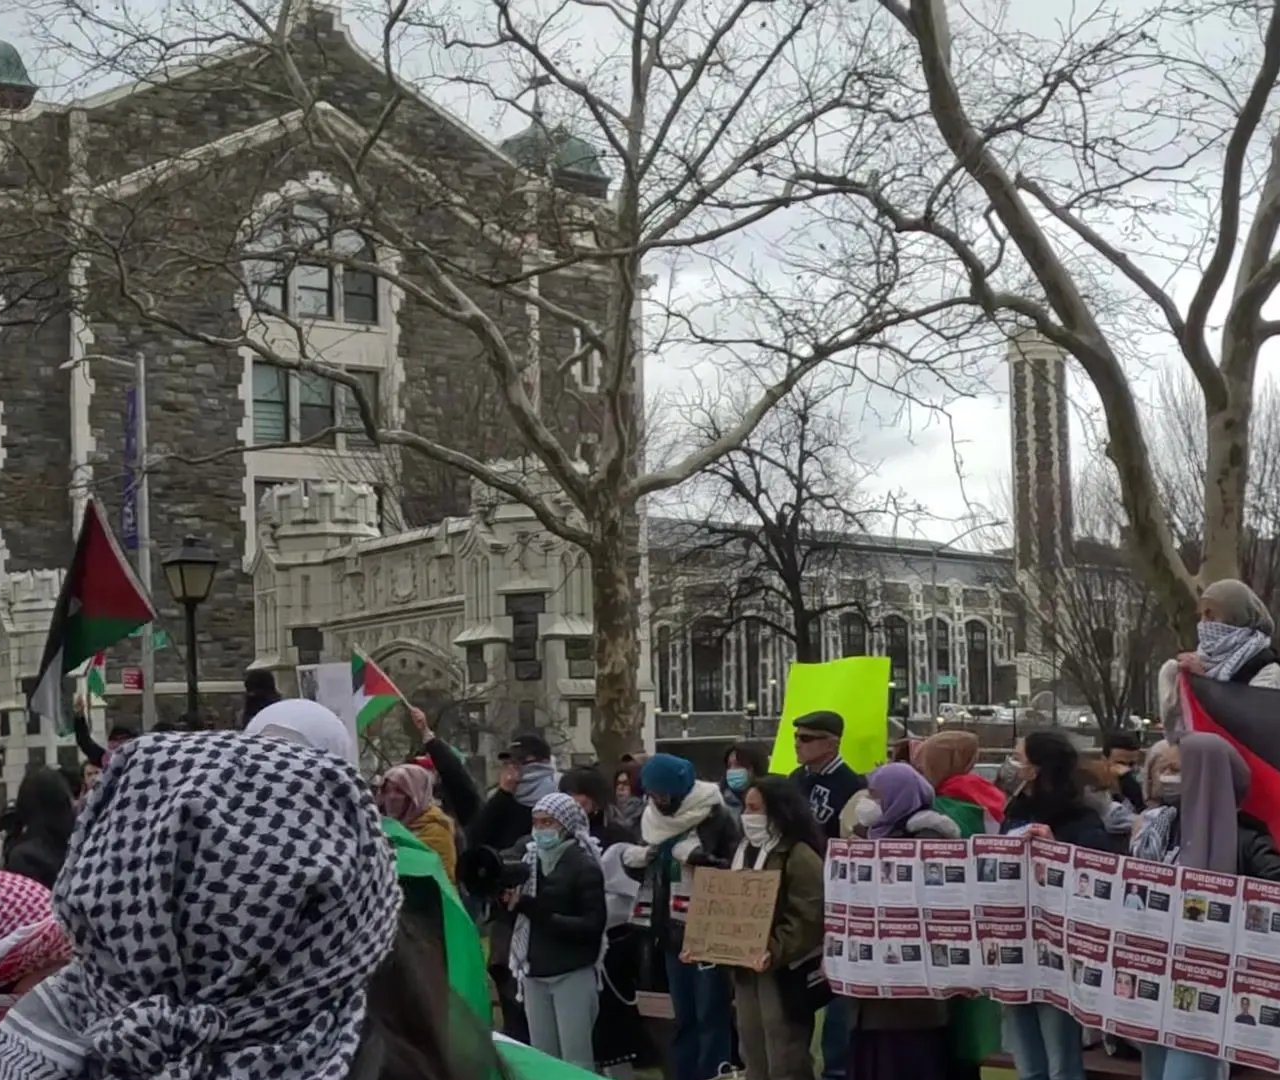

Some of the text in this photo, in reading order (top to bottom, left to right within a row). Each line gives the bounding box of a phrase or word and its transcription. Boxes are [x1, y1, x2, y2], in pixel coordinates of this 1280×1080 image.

[974, 837, 1023, 848] MURDERED
[1076, 849, 1116, 866] MURDERED
[1126, 860, 1174, 876] MURDERED
[1185, 870, 1235, 888] MURDERED
[1115, 948, 1164, 967] MURDERED
[1174, 962, 1224, 979] MURDERED
